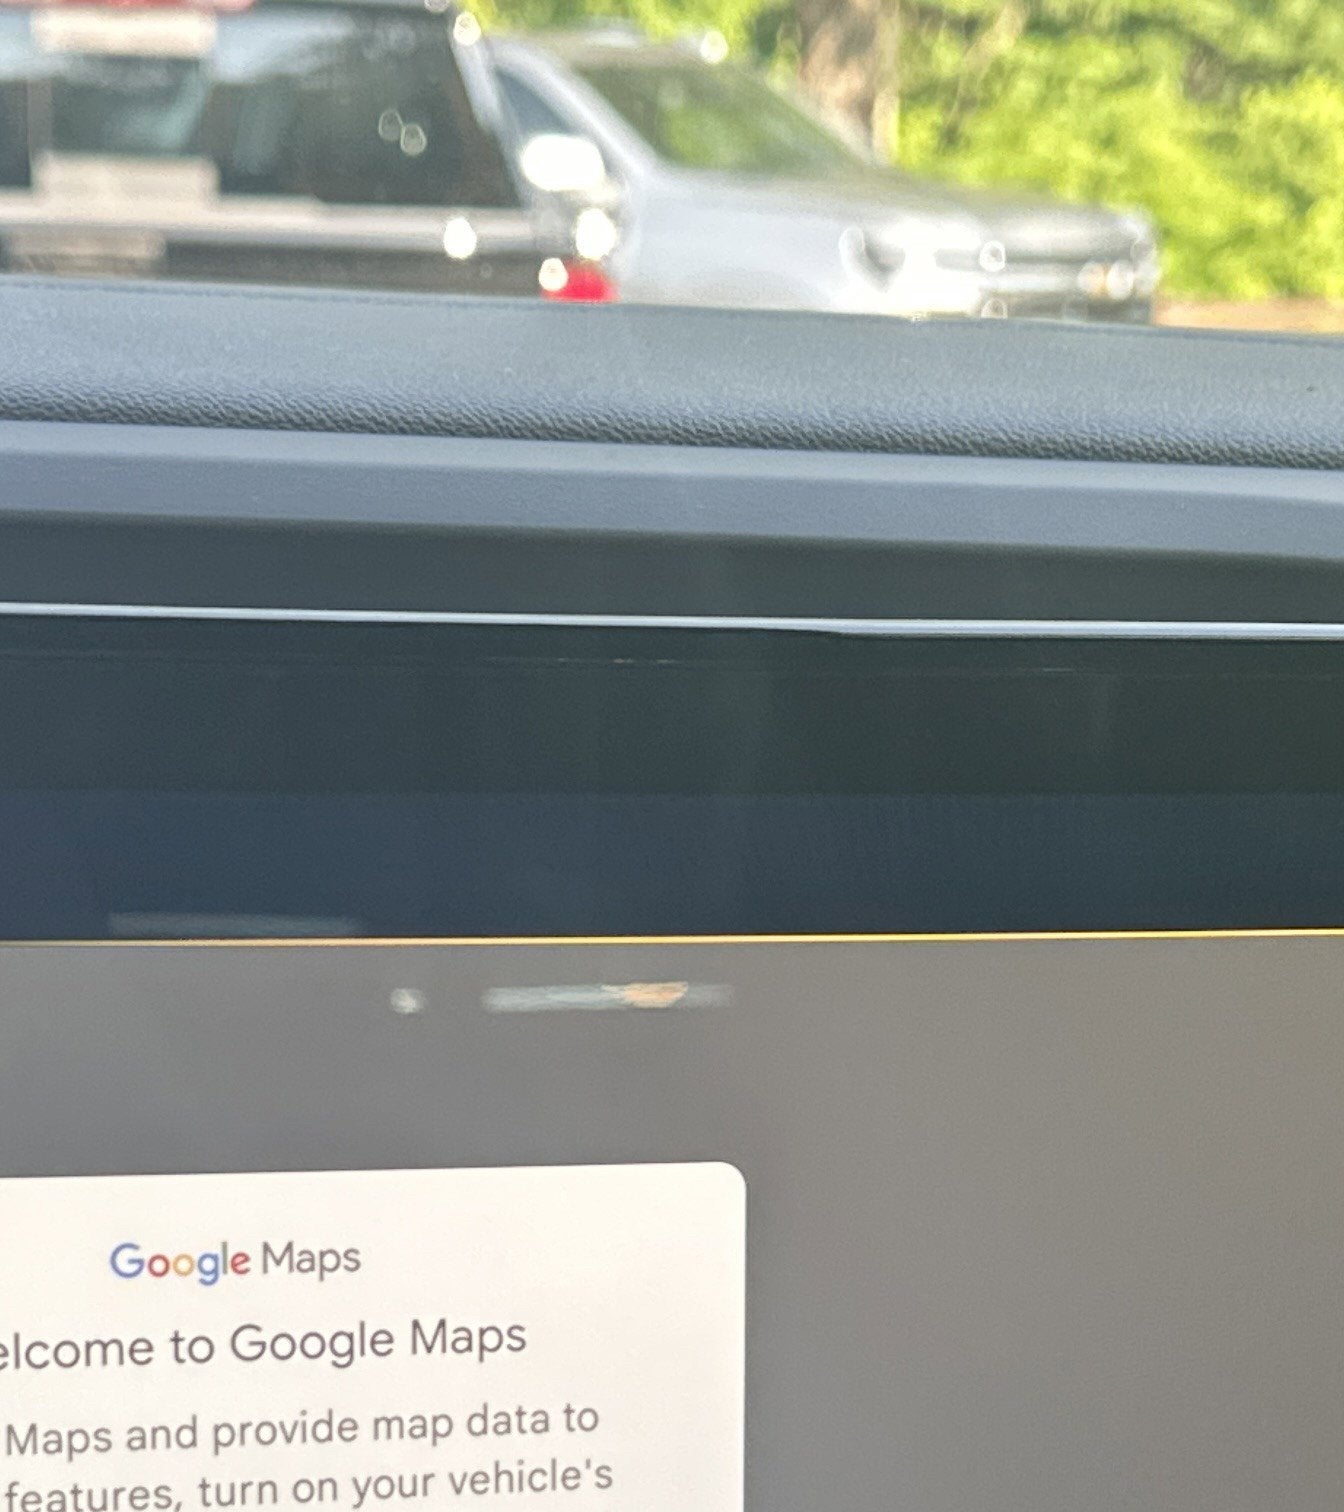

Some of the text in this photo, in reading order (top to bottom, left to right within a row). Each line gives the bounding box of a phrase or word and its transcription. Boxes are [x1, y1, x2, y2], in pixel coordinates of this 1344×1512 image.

[109, 1240, 362, 1287] Google Maps
[168, 1329, 215, 1365] to
[229, 1320, 395, 1370] Google
[410, 1317, 527, 1364] Maps
[5, 1422, 113, 1463] Maps
[125, 1413, 198, 1452] and
[212, 1407, 360, 1457] provide
[372, 1413, 454, 1448] map
[465, 1402, 550, 1438] data
[562, 1402, 600, 1433] to
[197, 1477, 279, 1508] turn
[291, 1477, 339, 1504] on
[351, 1472, 436, 1510] your
[448, 1457, 613, 1496] vehicle's
